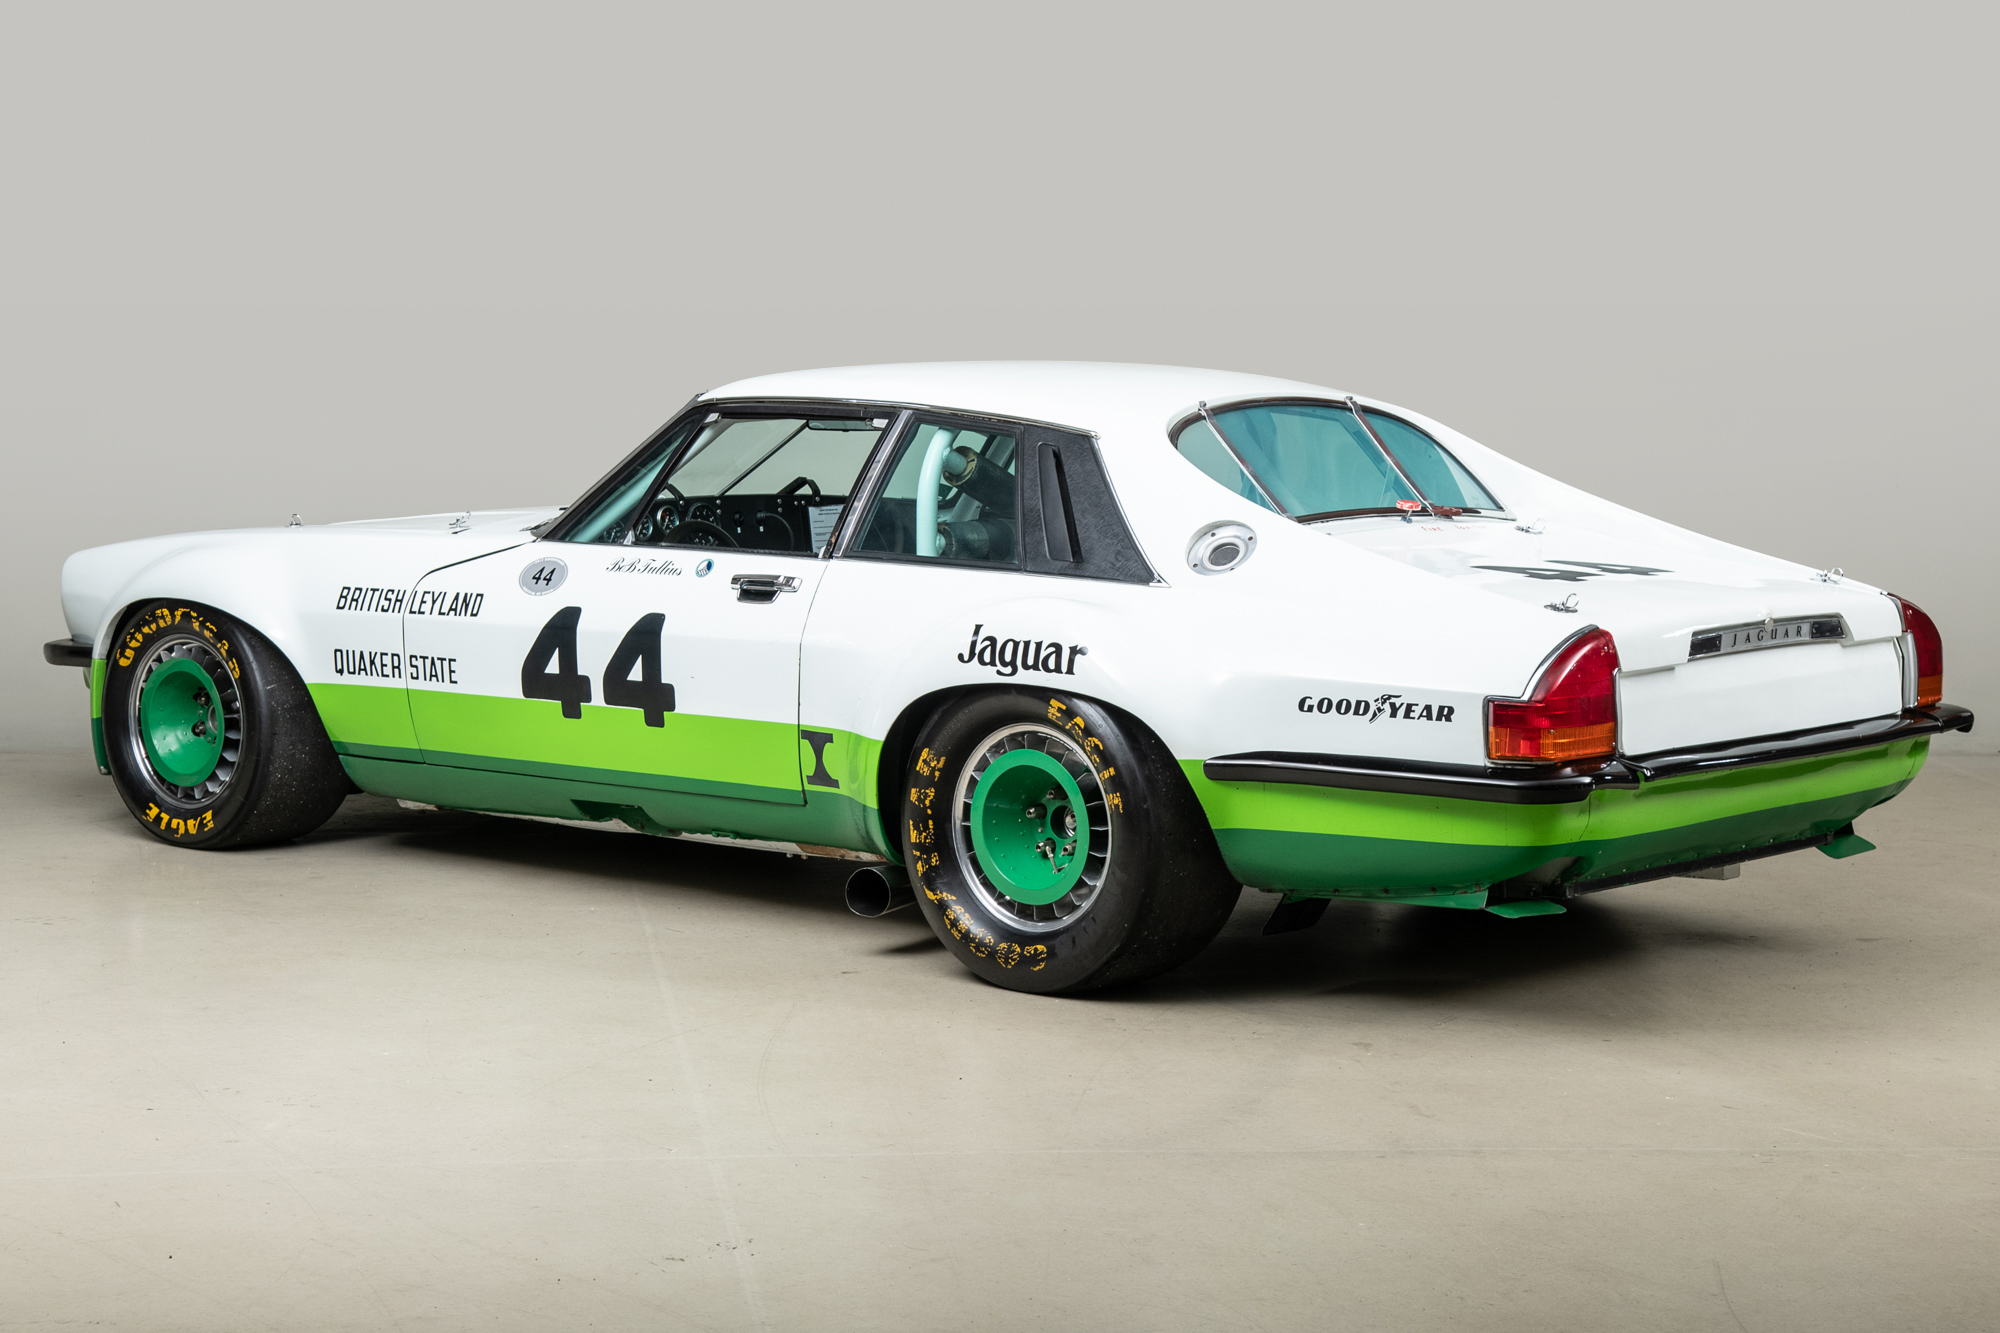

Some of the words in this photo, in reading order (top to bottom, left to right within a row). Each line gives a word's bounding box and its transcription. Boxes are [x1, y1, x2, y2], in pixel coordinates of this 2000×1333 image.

[531, 566, 556, 587] 44
[1469, 559, 1676, 582] 44
[336, 586, 406, 614] BRITISH
[408, 590, 484, 617] LEYLAND
[957, 624, 1089, 677] Jaguar
[1731, 625, 1802, 648] JAGUAR
[333, 648, 402, 679] QUAKER
[409, 654, 458, 684] STATE
[521, 606, 676, 728] 44
[142, 802, 214, 837] EAGLE
